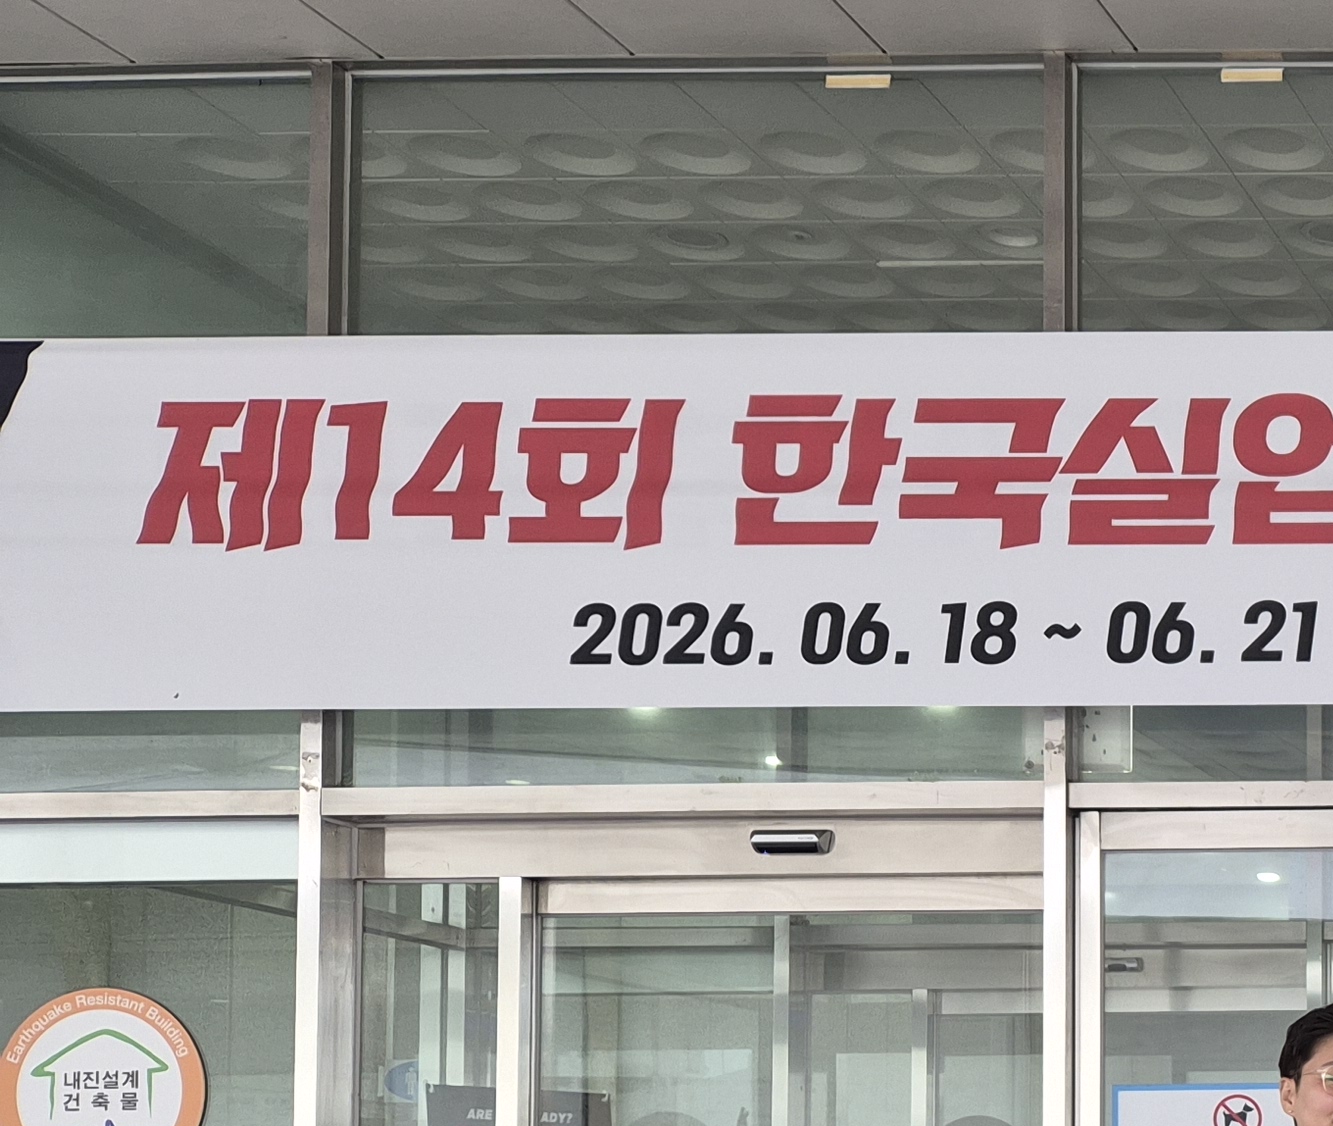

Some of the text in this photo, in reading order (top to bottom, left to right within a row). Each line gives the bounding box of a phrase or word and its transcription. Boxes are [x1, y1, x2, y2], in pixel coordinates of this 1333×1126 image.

[138, 399, 684, 550] 제14회
[570, 602, 773, 666] 2026.
[801, 602, 910, 666] 06.
[941, 601, 1018, 665] 18
[1107, 601, 1215, 665] 06.
[1241, 600, 1318, 663] 21
[7, 992, 188, 1064] Earthquake Resistant Building
[63, 1070, 139, 1090] 내진설계
[63, 1092, 139, 1112] 건축물
[467, 1108, 573, 1124] ARE ADY?
